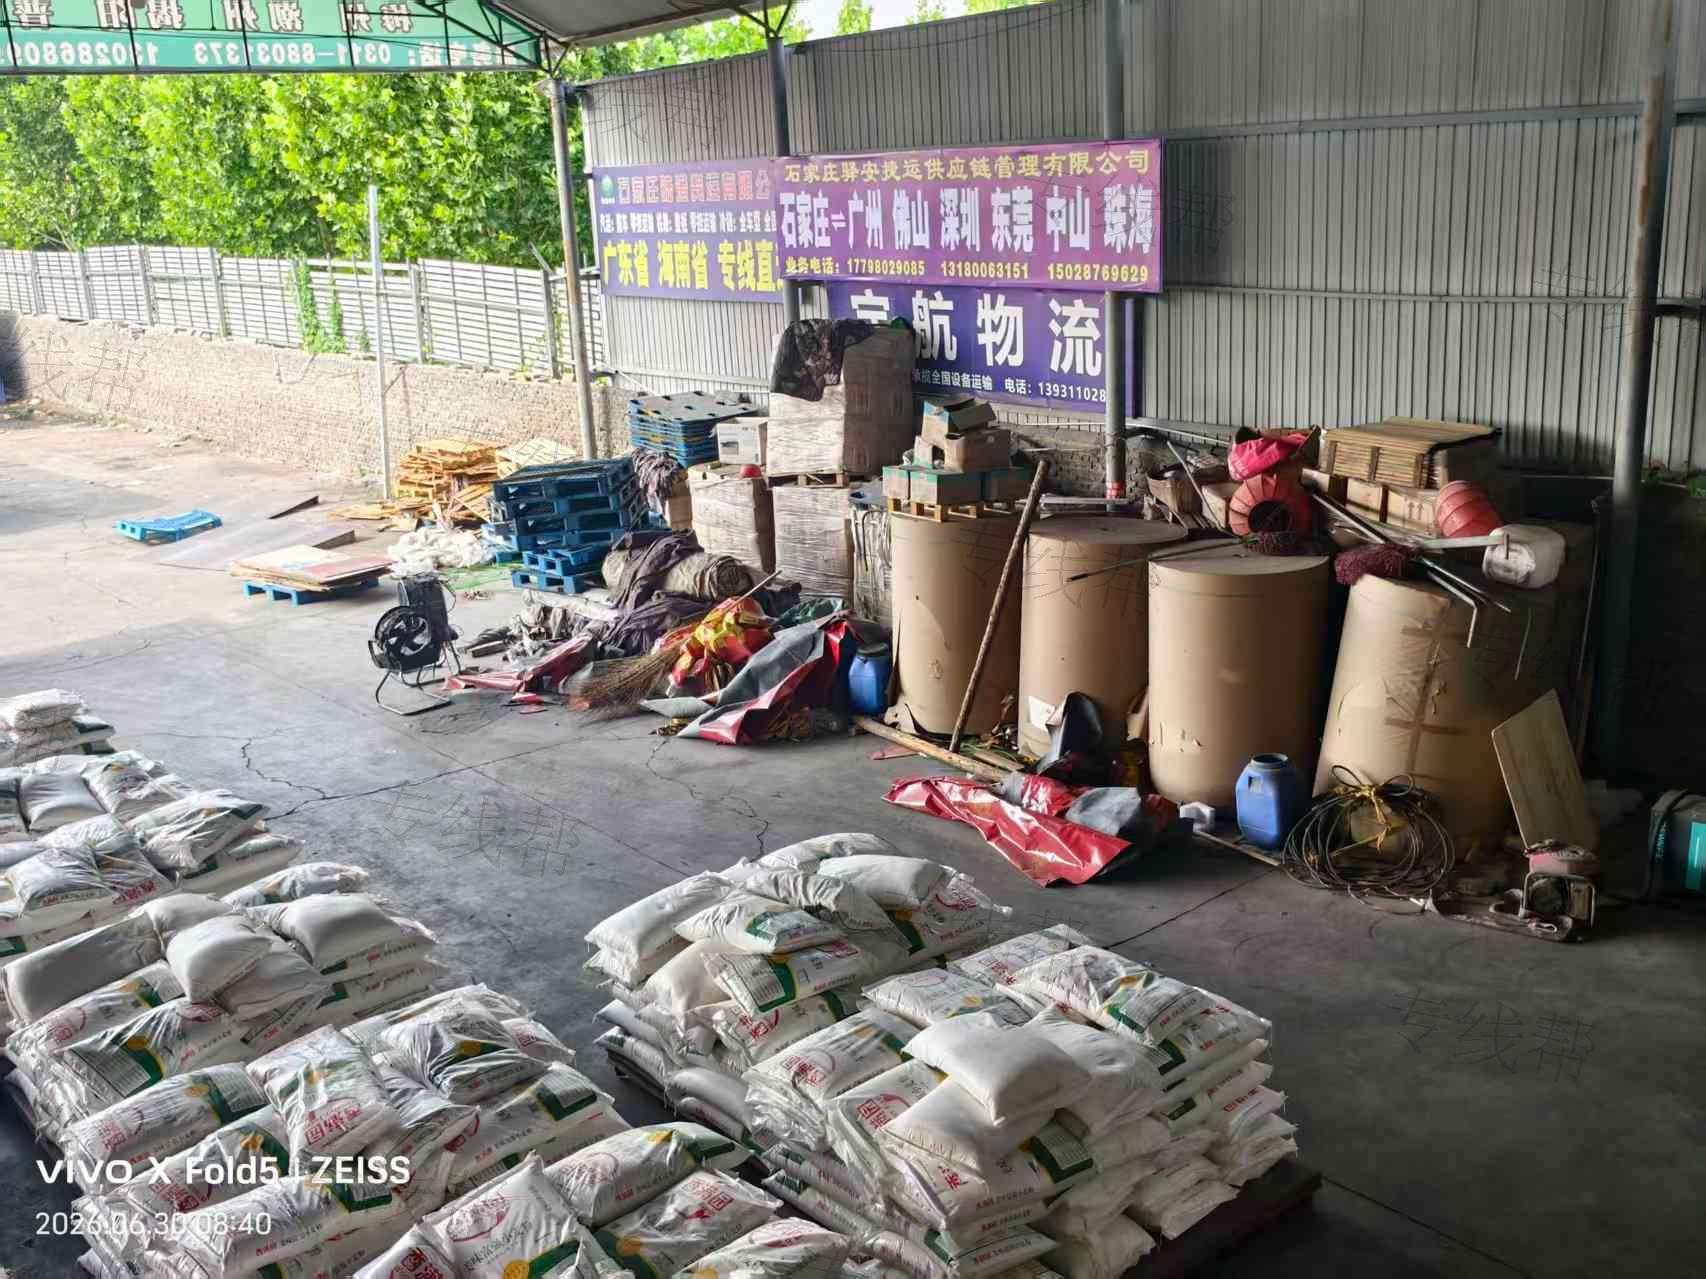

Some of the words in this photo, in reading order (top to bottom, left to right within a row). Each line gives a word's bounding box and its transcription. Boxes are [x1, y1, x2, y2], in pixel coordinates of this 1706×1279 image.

[780, 188, 831, 248] 石家庄
[848, 188, 884, 250] 广州
[892, 188, 931, 250] 佛山
[940, 187, 980, 251] 深圳
[991, 186, 1034, 252] 东莞
[1046, 185, 1090, 252] 中山
[1103, 184, 1153, 254] 珠海
[602, 239, 649, 288] 广东省
[657, 239, 709, 290] 海南省
[718, 239, 783, 292] 专线直
[847, 257, 925, 276] 17798029085
[941, 260, 1029, 280] 13180063151
[1047, 263, 1149, 282] 15028769629
